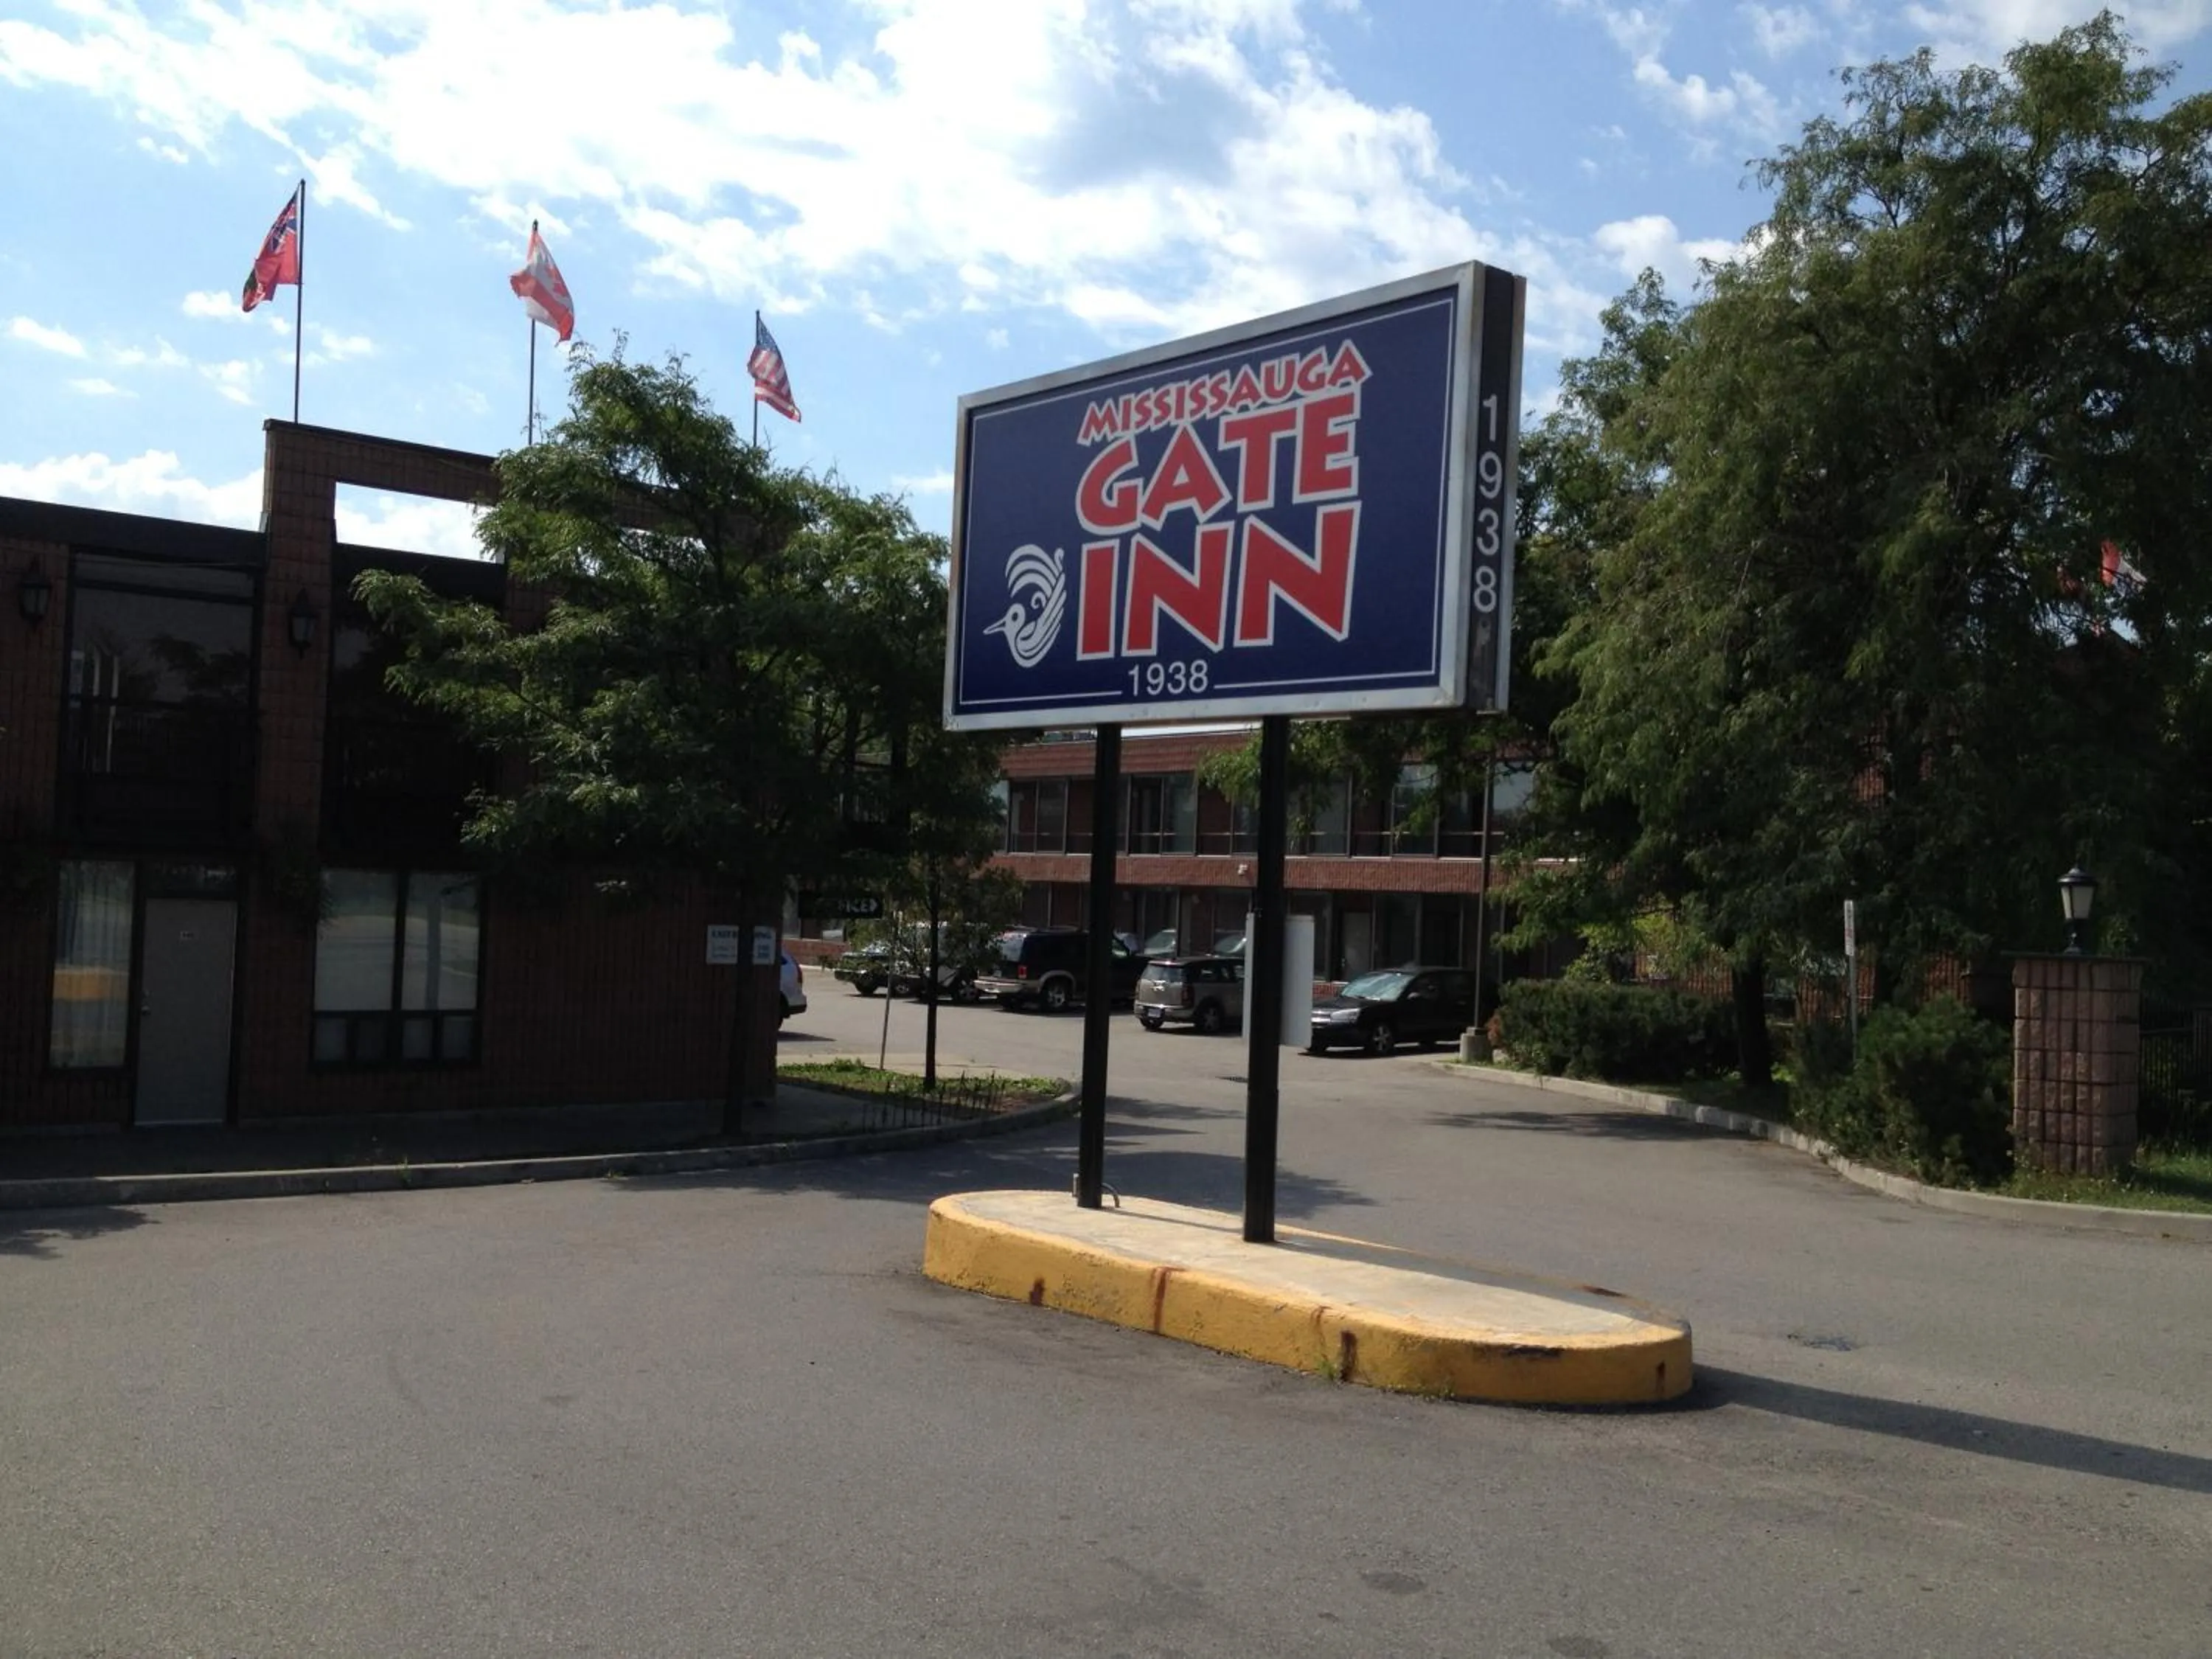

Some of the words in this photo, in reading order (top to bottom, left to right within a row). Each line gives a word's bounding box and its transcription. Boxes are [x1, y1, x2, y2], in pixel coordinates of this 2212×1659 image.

[1076, 386, 1360, 535] GATE
[1077, 339, 1373, 447] MISSISSAUGA
[1472, 393, 1503, 614] 1938
[1077, 501, 1363, 661] INN
[1127, 659, 1209, 697] 1938
